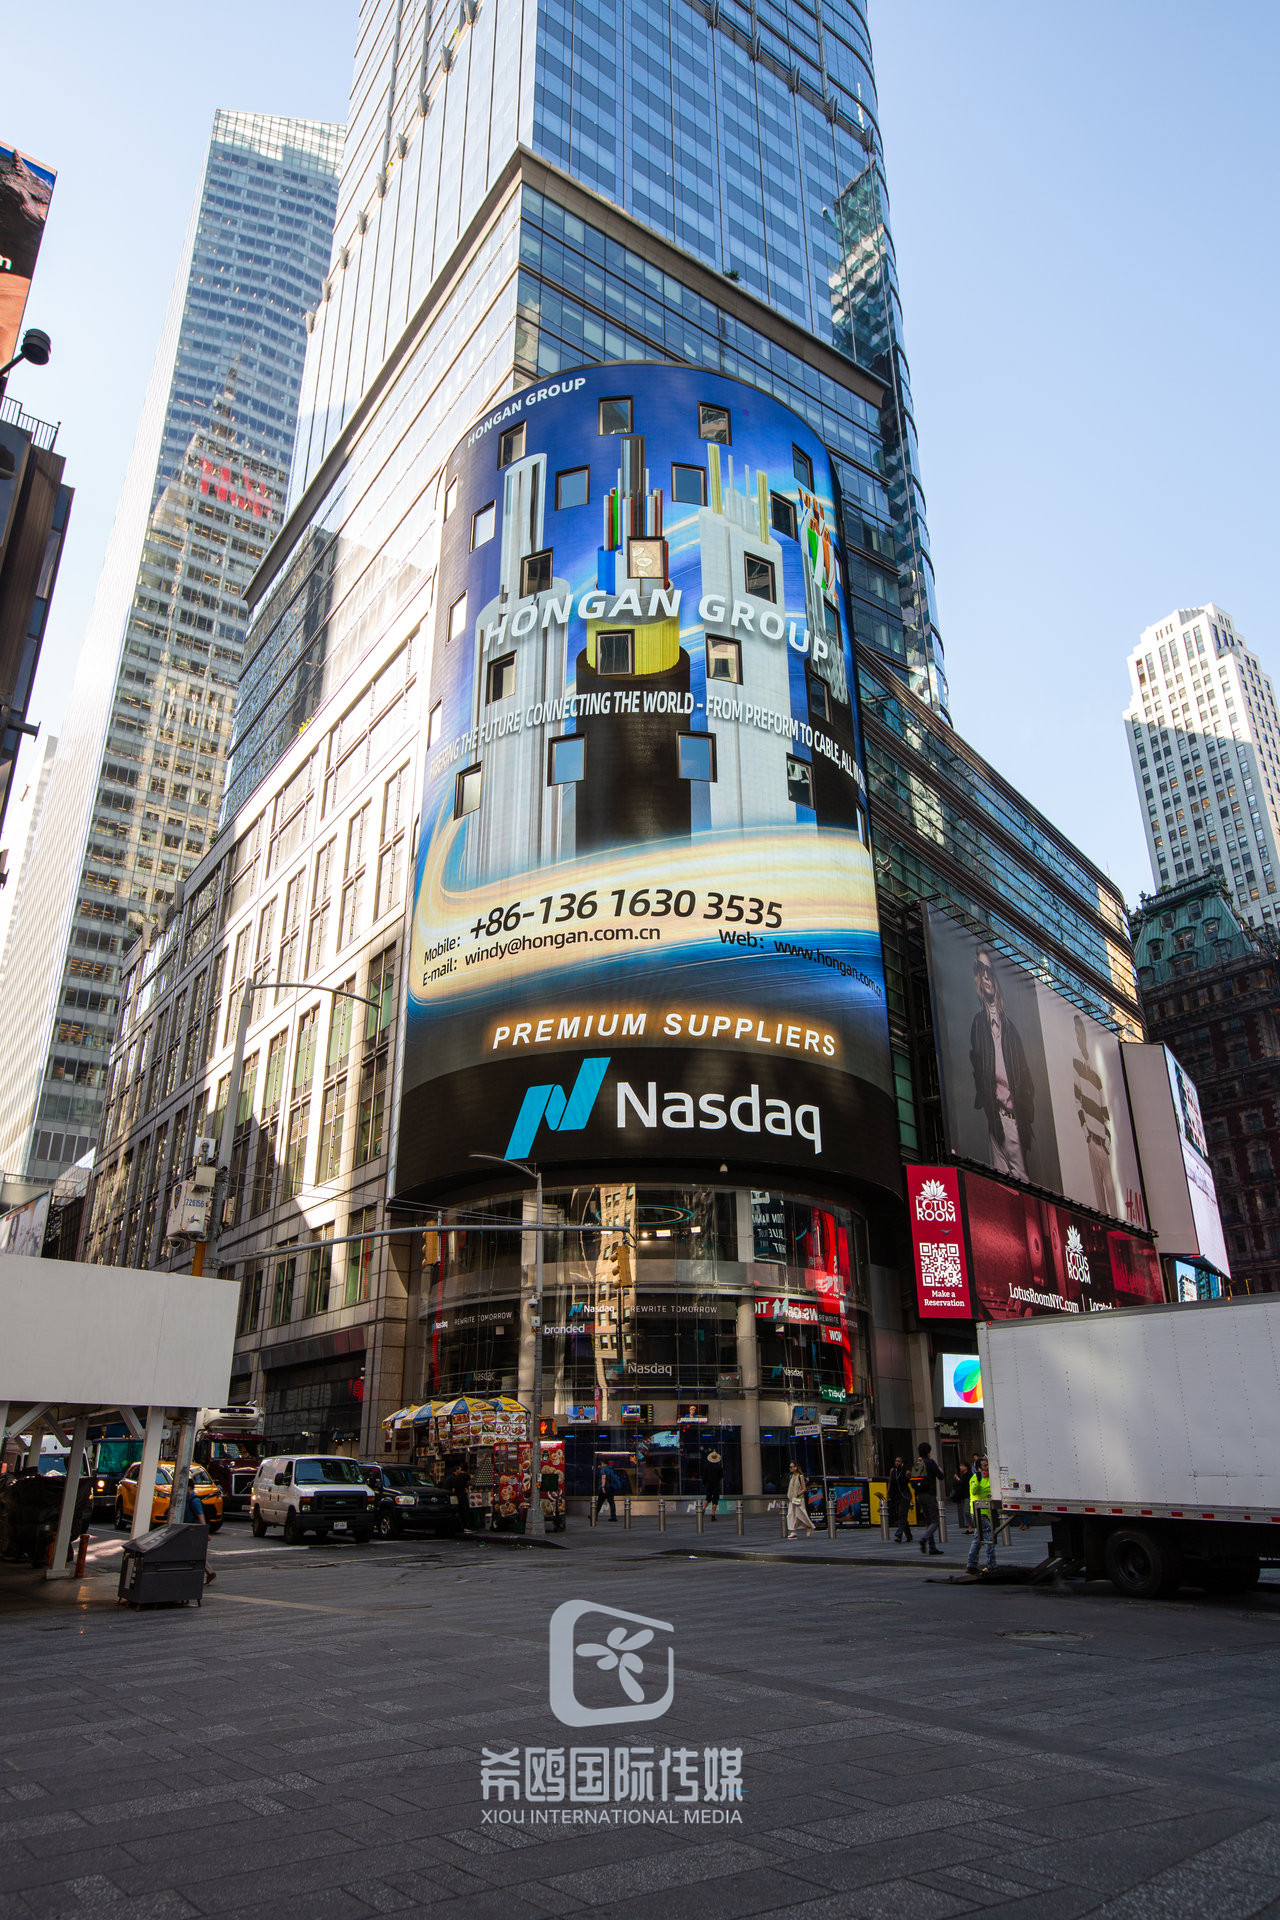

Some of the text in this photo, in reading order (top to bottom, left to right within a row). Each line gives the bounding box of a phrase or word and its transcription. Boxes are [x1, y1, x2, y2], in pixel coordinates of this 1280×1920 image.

[467, 377, 586, 448] HONGAN GROUP
[483, 588, 828, 662] HONGAN GROUP
[460, 727, 478, 756] THE
[479, 708, 523, 746] FUTURE,
[525, 691, 611, 727] CONNECTING
[613, 691, 641, 713] THE
[643, 691, 695, 714] WORLD
[705, 695, 743, 723] FROM
[745, 703, 799, 741] PREFORM
[799, 722, 813, 747] TO
[814, 730, 842, 769] CABLE,
[841, 749, 854, 778] ALL
[424, 888, 783, 965] Mobile: +86-136 1630 3535
[422, 927, 661, 987] E-mail: windy@hongan.com.cn
[718, 928, 882, 999] Web: www.hongan.com.cn
[492, 1013, 836, 1057] PREMIUM SUPPLIERS
[616, 1081, 823, 1155] Nasdaq
[915, 1199, 955, 1213] LOTUS
[917, 1209, 956, 1222] ROOM
[1065, 1250, 1089, 1271] LOTUS
[1068, 1261, 1091, 1285] ROOM
[924, 1299, 965, 1307] Reservation
[931, 1290, 951, 1298] Make
[1008, 1282, 1079, 1313] LotusRoomNYC.com
[477, 1311, 513, 1322] TOMORROW
[583, 1304, 718, 1315] Nasdaq REWRITE TOMORROW
[628, 1362, 672, 1376] Nasdaq
